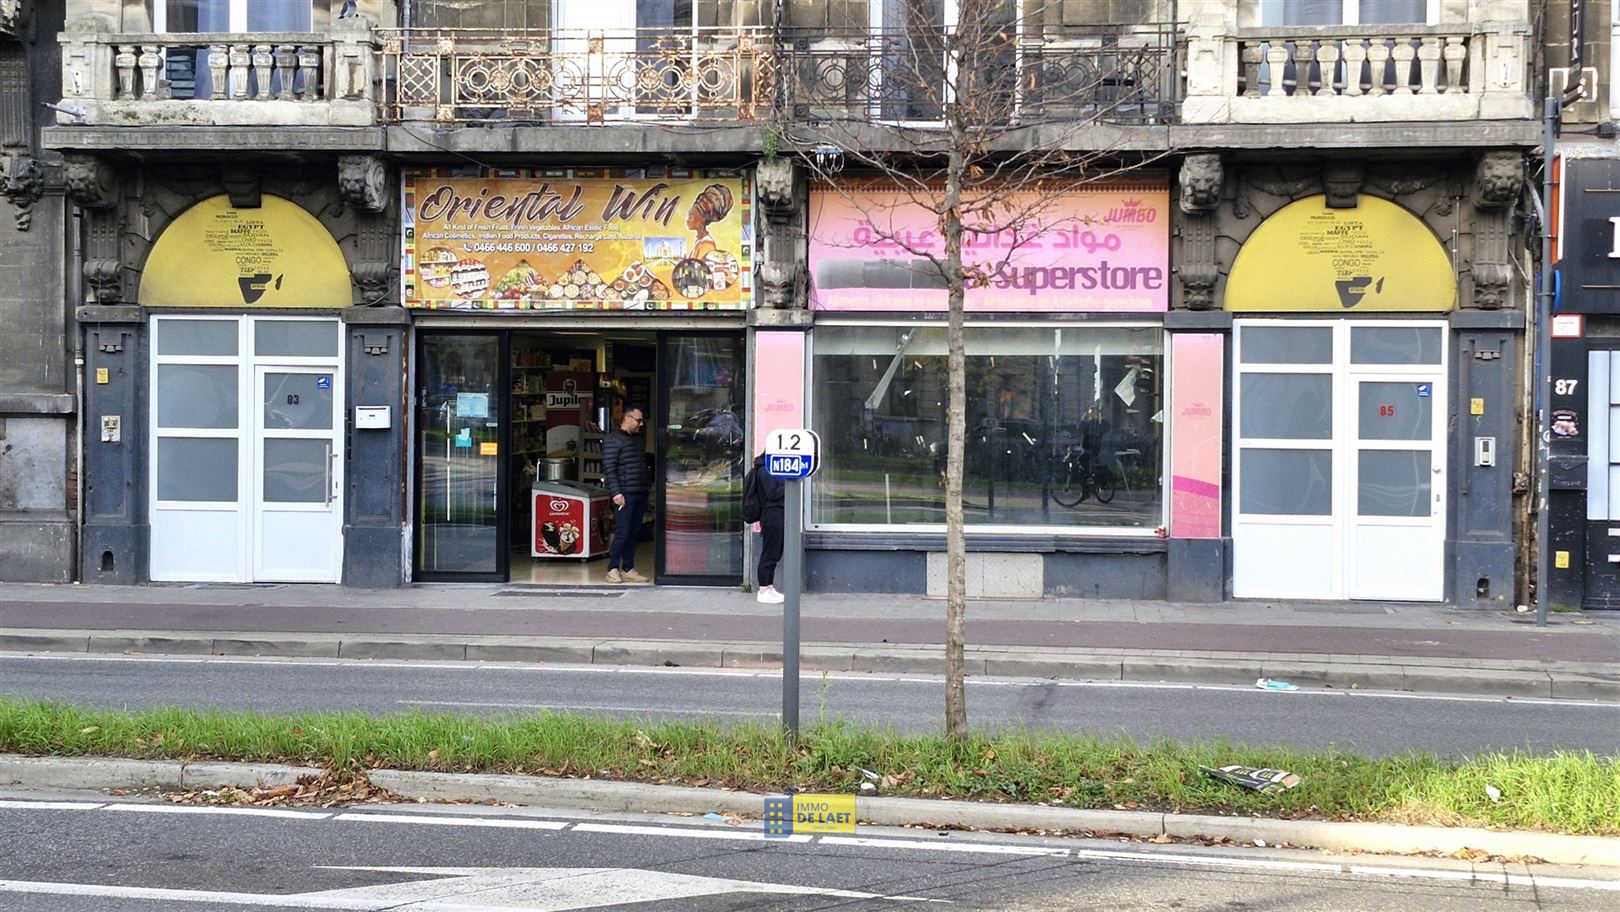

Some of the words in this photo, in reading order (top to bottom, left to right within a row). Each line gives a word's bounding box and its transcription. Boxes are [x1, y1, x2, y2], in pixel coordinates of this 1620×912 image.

[419, 182, 584, 225] Oriental
[601, 182, 681, 227] Win
[1104, 208, 1157, 223] JUMBO
[1053, 225, 1121, 254] مواد
[474, 243, 495, 253] 0466
[497, 243, 513, 253] 446
[514, 243, 531, 253] 600
[536, 243, 558, 253] 0466
[559, 243, 576, 253] 427
[578, 243, 594, 253] 192
[994, 260, 1163, 296] Superstore
[1555, 379, 1578, 395] 87
[287, 394, 300, 405] 83
[1380, 405, 1394, 417] 85
[777, 434, 801, 451] 1.2
[773, 458, 799, 472] N184
